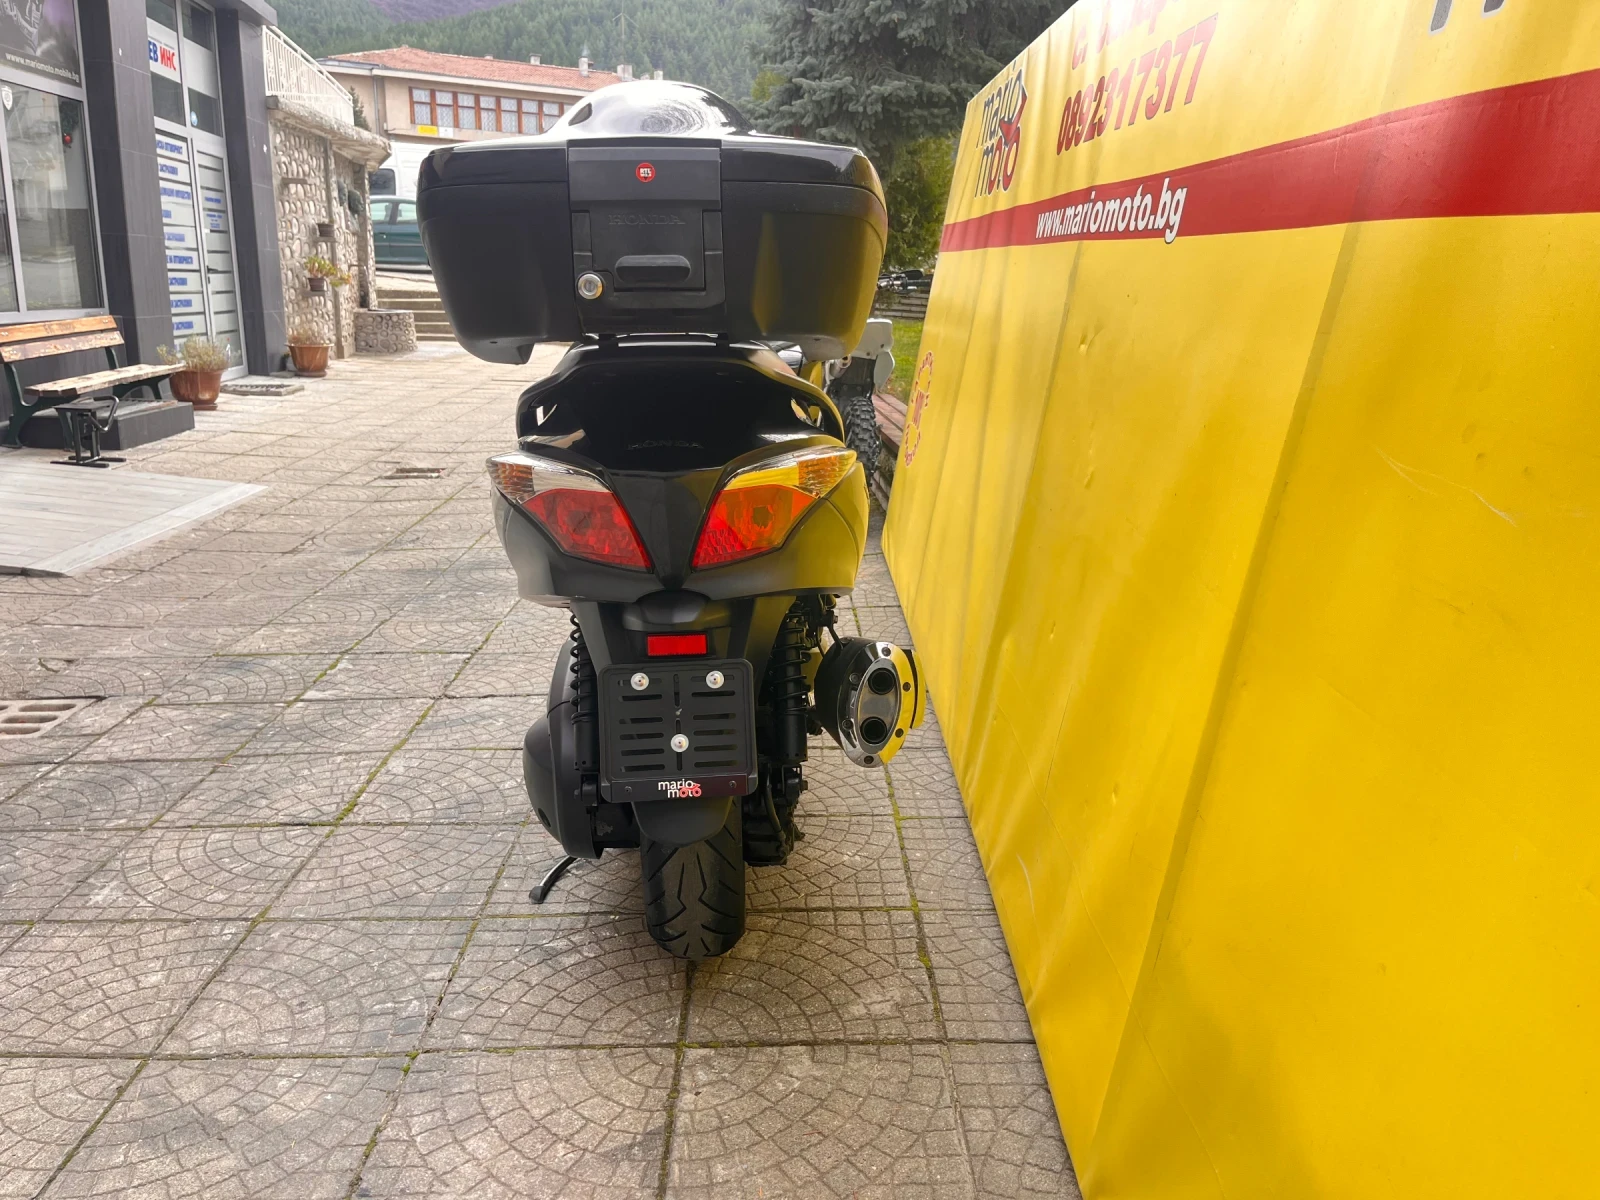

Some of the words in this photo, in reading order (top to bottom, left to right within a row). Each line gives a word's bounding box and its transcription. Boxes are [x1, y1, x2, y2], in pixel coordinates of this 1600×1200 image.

[5, 52, 80, 83] www.mariomoto.mobile.bg
[159, 45, 177, 72] ИНС
[1056, 12, 1219, 156] 0892317377
[976, 58, 1023, 149] mario
[974, 124, 1021, 198] moto
[608, 214, 687, 226] HONDA
[1035, 177, 1188, 244] www.mariomoto.bg
[657, 778, 694, 791] mario
[667, 787, 702, 799] moto
